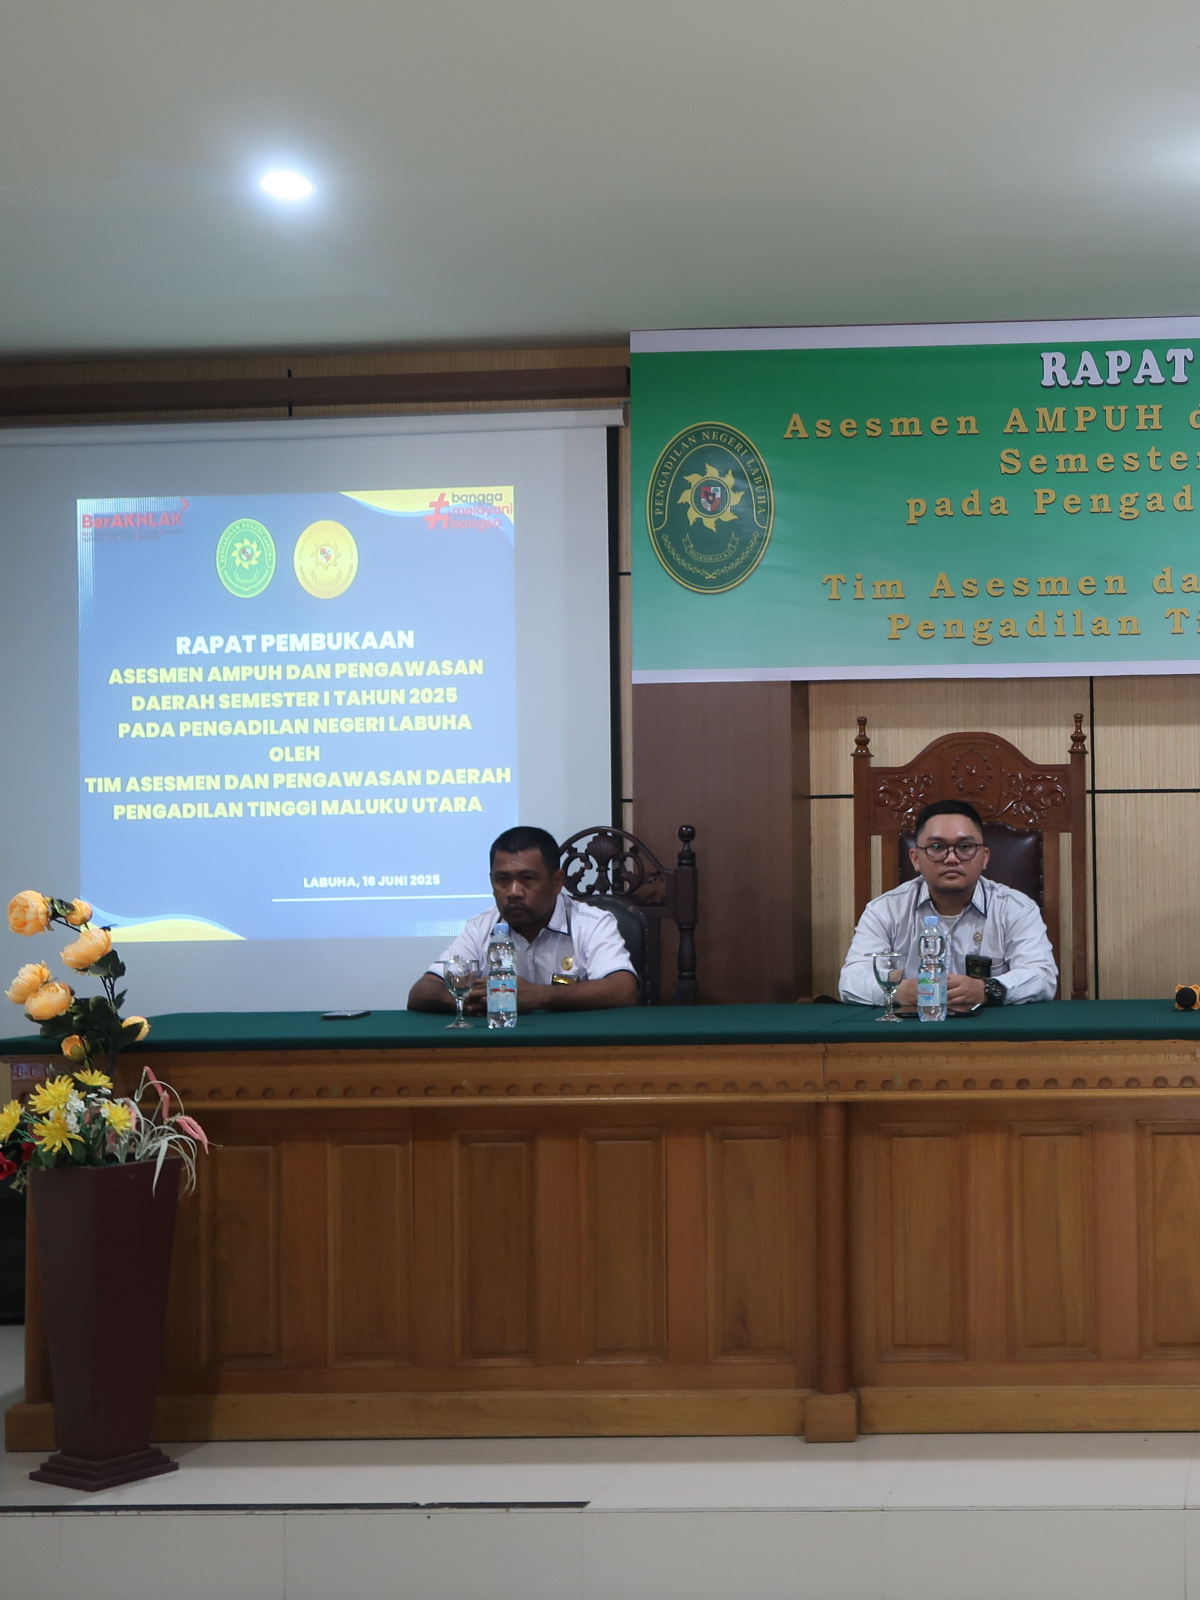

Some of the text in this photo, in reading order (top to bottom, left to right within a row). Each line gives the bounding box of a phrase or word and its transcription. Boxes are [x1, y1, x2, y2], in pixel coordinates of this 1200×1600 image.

[1040, 347, 1195, 389] RAPAT
[783, 412, 980, 440] Asesmen
[1002, 403, 1164, 435] AMPUH
[655, 431, 766, 515] PENGADILAN NEGERI LABUHA
[451, 503, 513, 518] melayani
[452, 492, 503, 505] bangga
[906, 488, 1010, 526] pada
[82, 512, 184, 529] BerAKHLAK
[822, 572, 907, 602] Tim
[929, 571, 1128, 599] Asesmen
[887, 608, 1142, 647] Pengadilan
[176, 630, 415, 655] RAPAT PEMBUKAAN
[108, 659, 484, 685] ASESMEN AMPUH DAN PENGAWASAN
[131, 687, 458, 711] DAERAH SEMESTER I TAHUN 2025
[118, 714, 472, 738] PADA PENGADILAN NEGERI LABUHA
[269, 746, 320, 763] OLEH
[85, 767, 511, 793] TIM ASESMEN DAN PENGAWASAN DAERAH
[113, 796, 483, 820] PENGADILAN TINGGI MALUKU UTARA
[303, 873, 440, 889] LABUHA, 16 JUNI 2025
